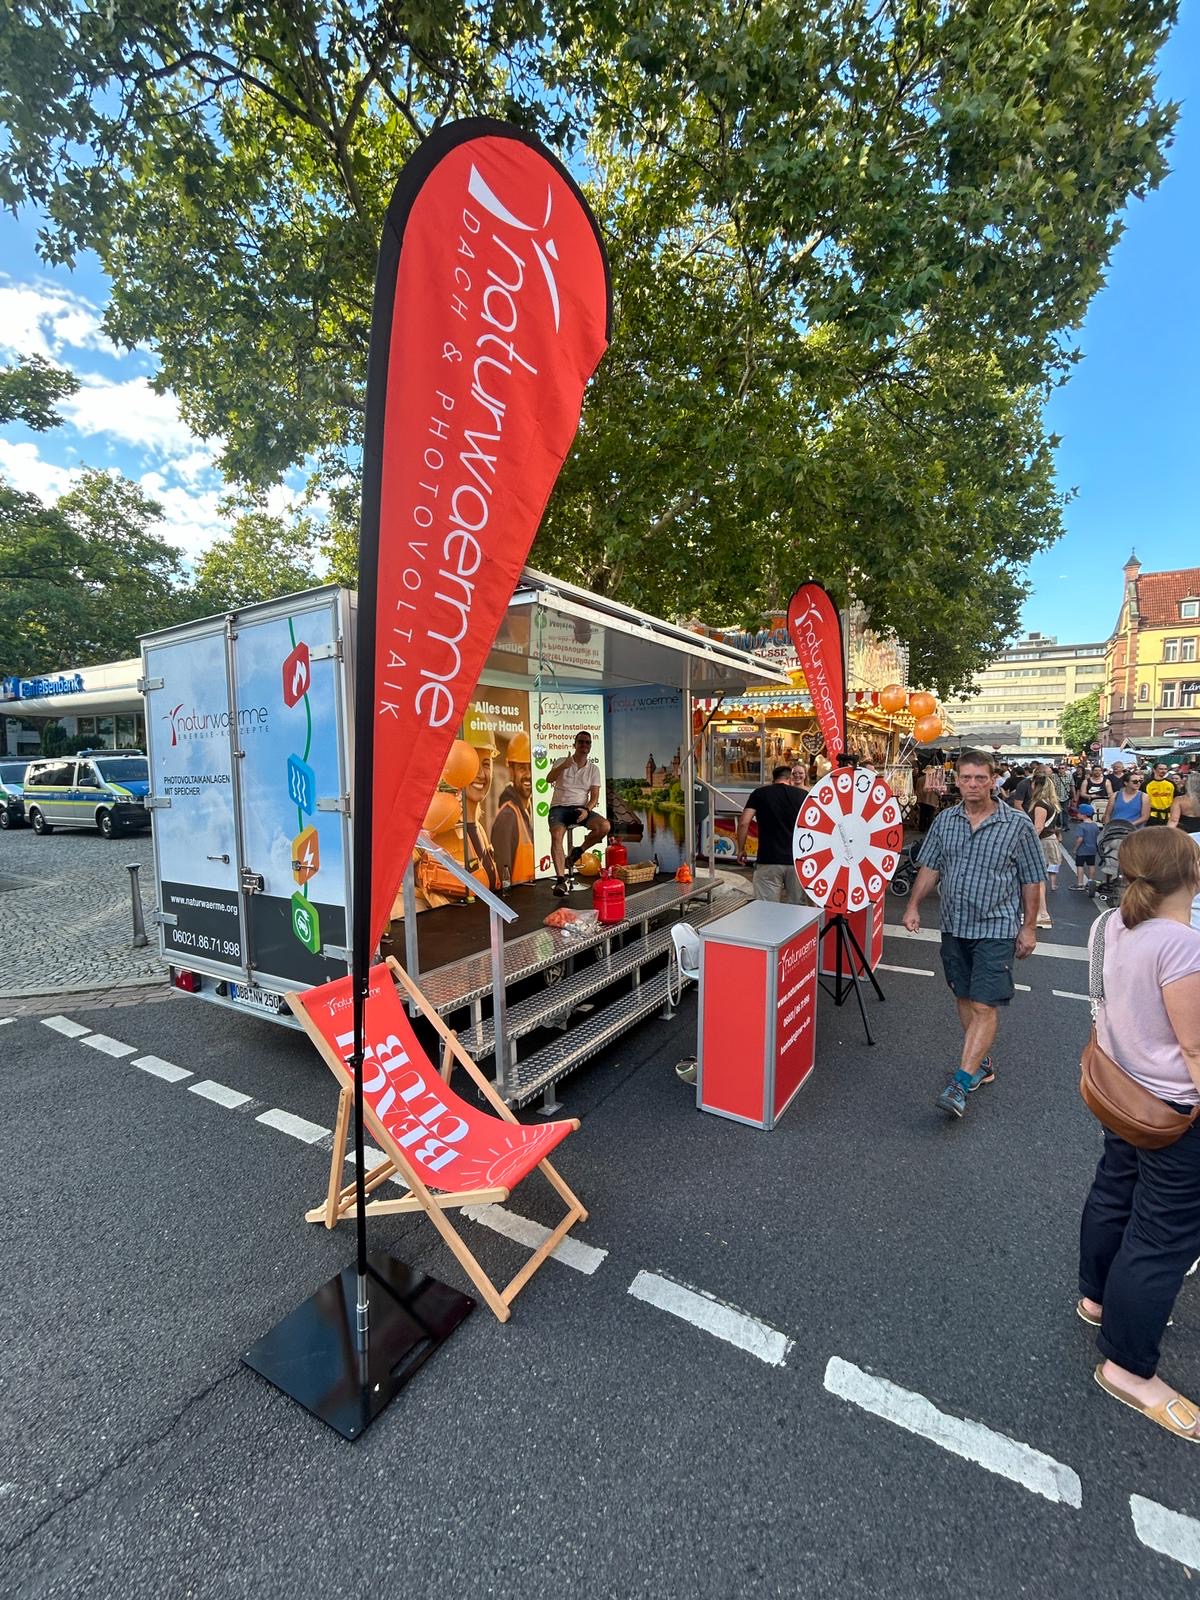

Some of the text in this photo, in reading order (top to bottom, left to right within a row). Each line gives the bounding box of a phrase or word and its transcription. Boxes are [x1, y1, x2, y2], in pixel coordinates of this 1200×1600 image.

[379, 208, 481, 720] DACH & PHOTOVOLTAIK
[415, 234, 538, 728] naturwaerme
[803, 620, 843, 751] naturwaerme
[475, 701, 520, 716] Alles aus
[178, 726, 270, 740] ENERGIE-KOZEPTE
[470, 717, 524, 732] einer Hand
[536, 733, 548, 741] für
[548, 733, 576, 741] Photovo
[163, 775, 231, 785] PHOTOVOLTAIKANLAGEN
[164, 787, 201, 796] MIT SPEICHER
[170, 895, 238, 915] www.naturwaerme.org
[172, 929, 241, 957] 06021.86.71.998
[376, 1034, 469, 1143] CLUB
[334, 1029, 464, 1173] BEACH
